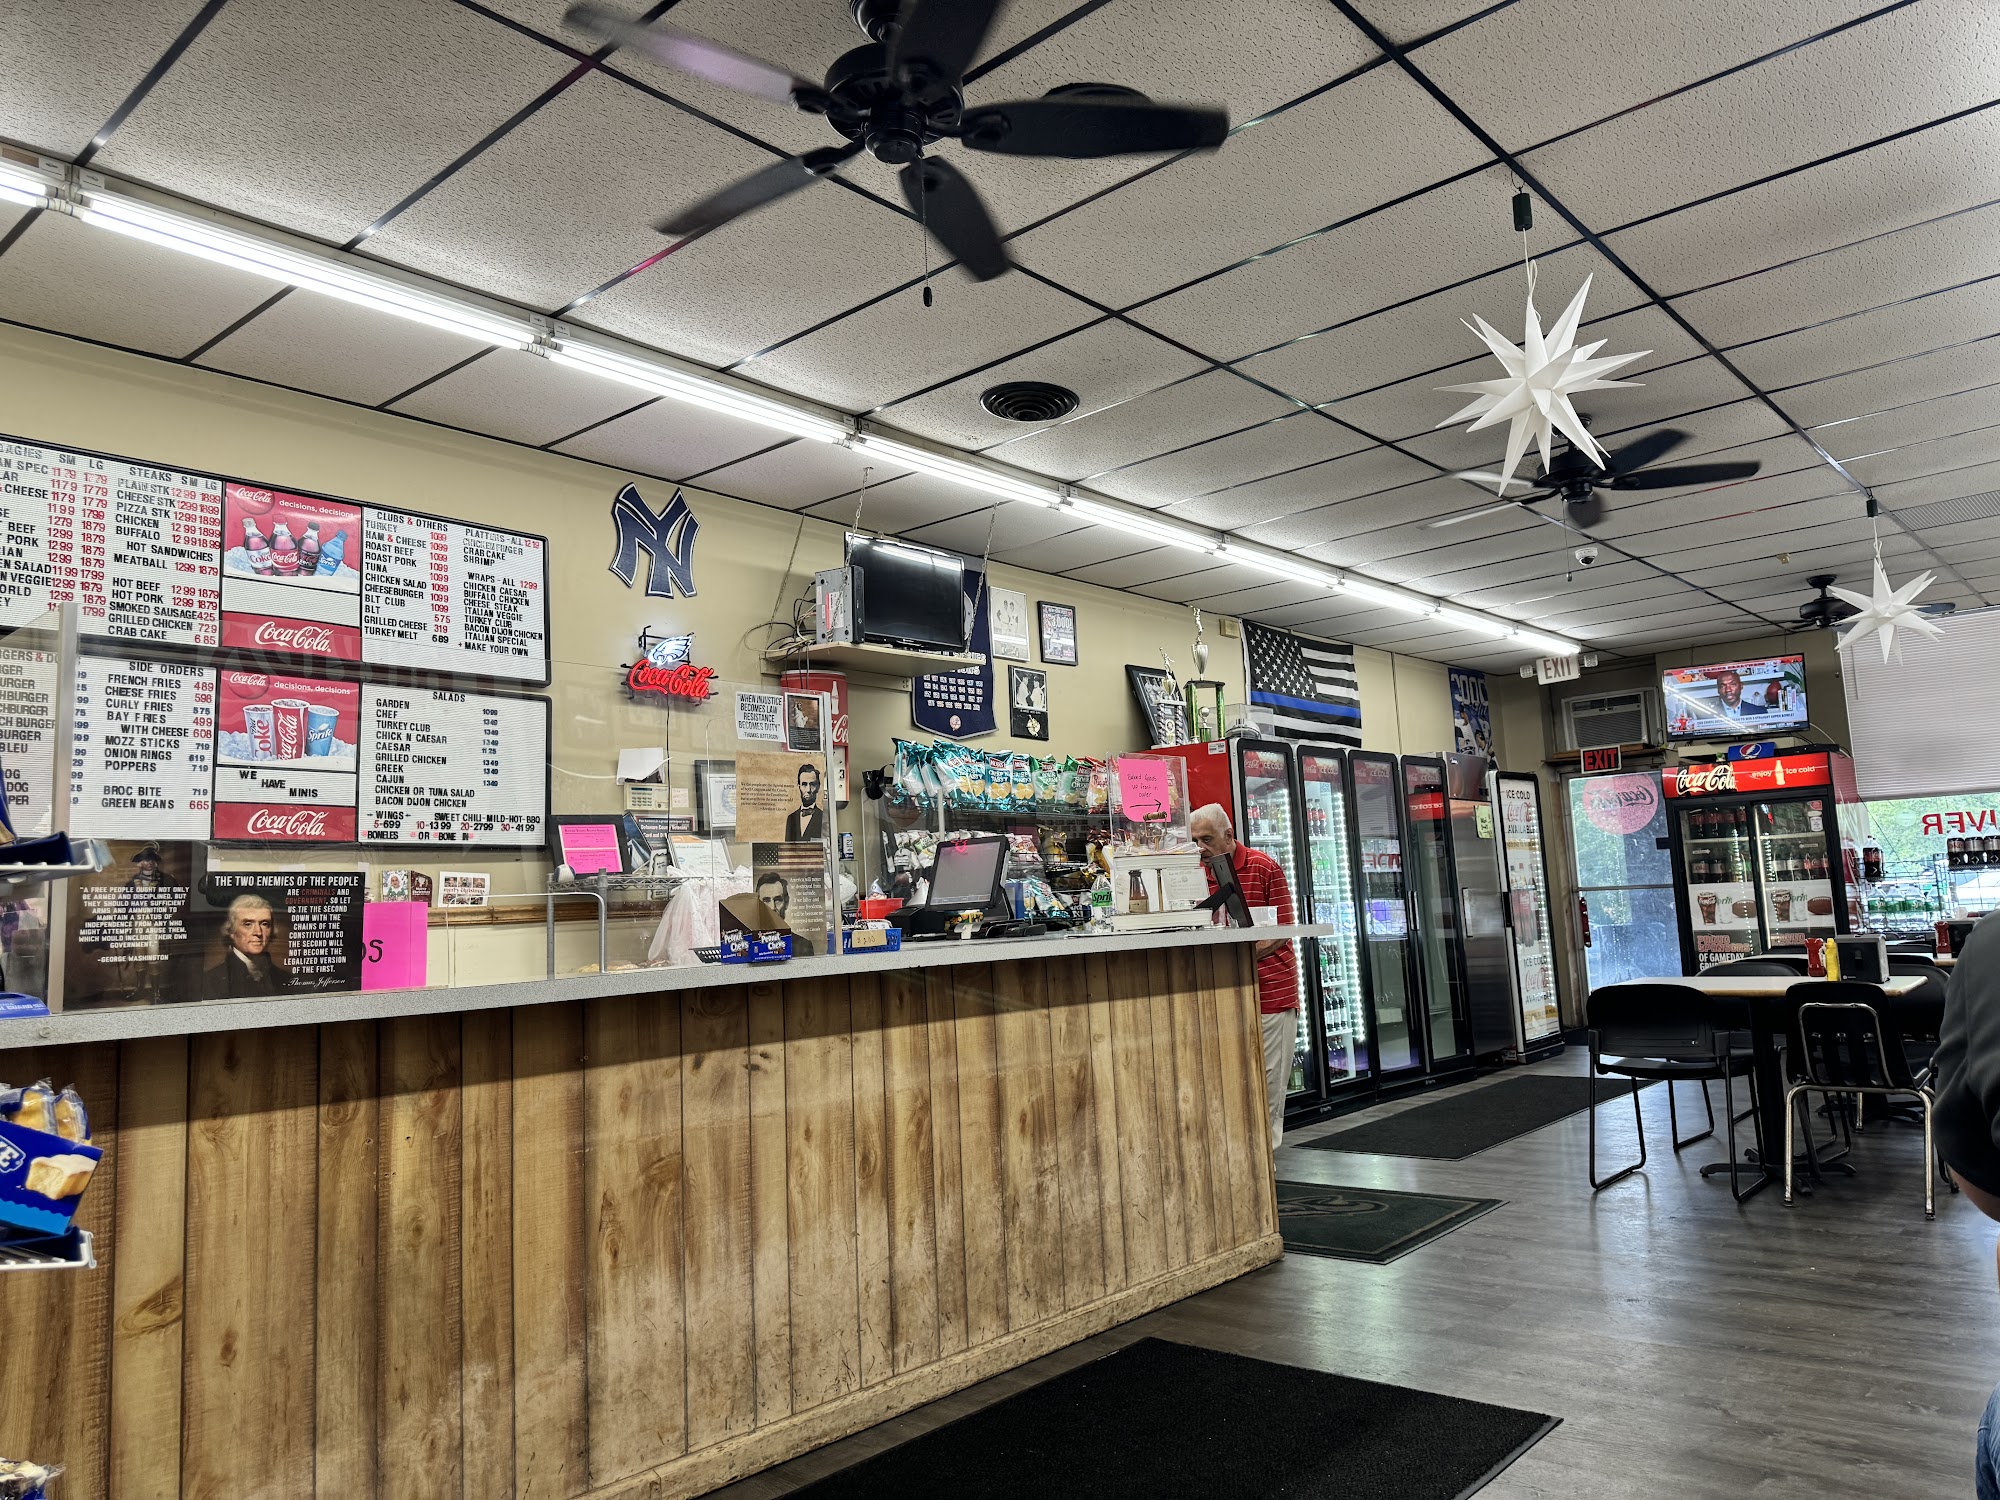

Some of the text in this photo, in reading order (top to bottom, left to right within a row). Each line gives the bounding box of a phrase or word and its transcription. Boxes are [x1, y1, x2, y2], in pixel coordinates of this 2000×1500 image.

[17, 460, 48, 474] SPEC
[59, 454, 104, 470] SM LG
[129, 466, 172, 482] STEAKS
[4, 483, 48, 499] CHEESE
[116, 501, 170, 519] PIZZA STK
[279, 499, 318, 512] decisions,
[115, 513, 159, 528] CHICKEN
[376, 511, 448, 532] CLUBS & OTHERS
[365, 529, 426, 548] HAM & CHEESE
[126, 541, 213, 562] HOT SANDWICHES
[113, 553, 168, 569] MEATBALL
[365, 552, 417, 568] ROAST PORK
[365, 562, 388, 573] TUNA
[467, 571, 495, 583] WRAPS
[364, 583, 424, 600] CHEESEBURGER
[109, 601, 150, 614] SMOKED
[153, 606, 198, 620] SAUSAGE
[364, 615, 428, 631] GRILLED CHEESE
[108, 625, 167, 640] CRAB CAKE
[254, 621, 334, 652] Coca-Cola
[464, 642, 528, 656] MAKE YOUR OWN
[129, 661, 204, 677] SIDE ORDERS
[1543, 656, 1572, 680] EXIT
[108, 674, 214, 692] FRENCH FRIES 489
[627, 659, 714, 698] Coca-Cola
[274, 681, 350, 695] decisions, decisions
[432, 691, 466, 702] SALADS
[756, 695, 782, 706] INJUSTICE
[376, 698, 410, 710] GARDEN
[740, 703, 778, 714] BECOMES LAW
[743, 712, 774, 722] RESISTANCE
[738, 720, 764, 730] BECOMES
[307, 726, 332, 742] Sprite
[105, 736, 180, 749] MOZZ STICKS
[376, 742, 410, 752] CAESAR
[104, 748, 172, 760] ONION RINGS
[1584, 750, 1618, 770] EXIT
[105, 760, 157, 772] POPPERS
[375, 763, 404, 772] GREEK
[239, 770, 257, 780] WE
[1677, 765, 1737, 796] Coca-Cola
[1751, 770, 1772, 778] enjoy
[261, 779, 286, 789] HAVE
[289, 788, 318, 798] MINIS
[375, 785, 474, 798] CHICKEN OR TUNA SALAD
[1506, 789, 1530, 800] ICE COLD
[101, 798, 210, 810] GREEN BEANS 665
[376, 810, 404, 820] WINGS
[247, 808, 329, 836] Coca-Cola
[214, 875, 359, 886] THE TWO ENEMIES OF THE PEOPLE
[337, 888, 350, 896] AND
[291, 914, 310, 922] DOWN
[288, 931, 334, 939] CONSTITUTION
[724, 930, 744, 944] Peanut
[761, 932, 781, 944] Peanut
[288, 940, 300, 948] THE
[128, 954, 168, 962] WASHINGTON
[284, 956, 346, 966] LEGALIZED VERSION
[1698, 953, 1708, 962] OF
[302, 966, 314, 974] THE
[316, 965, 336, 973] FIRST.
